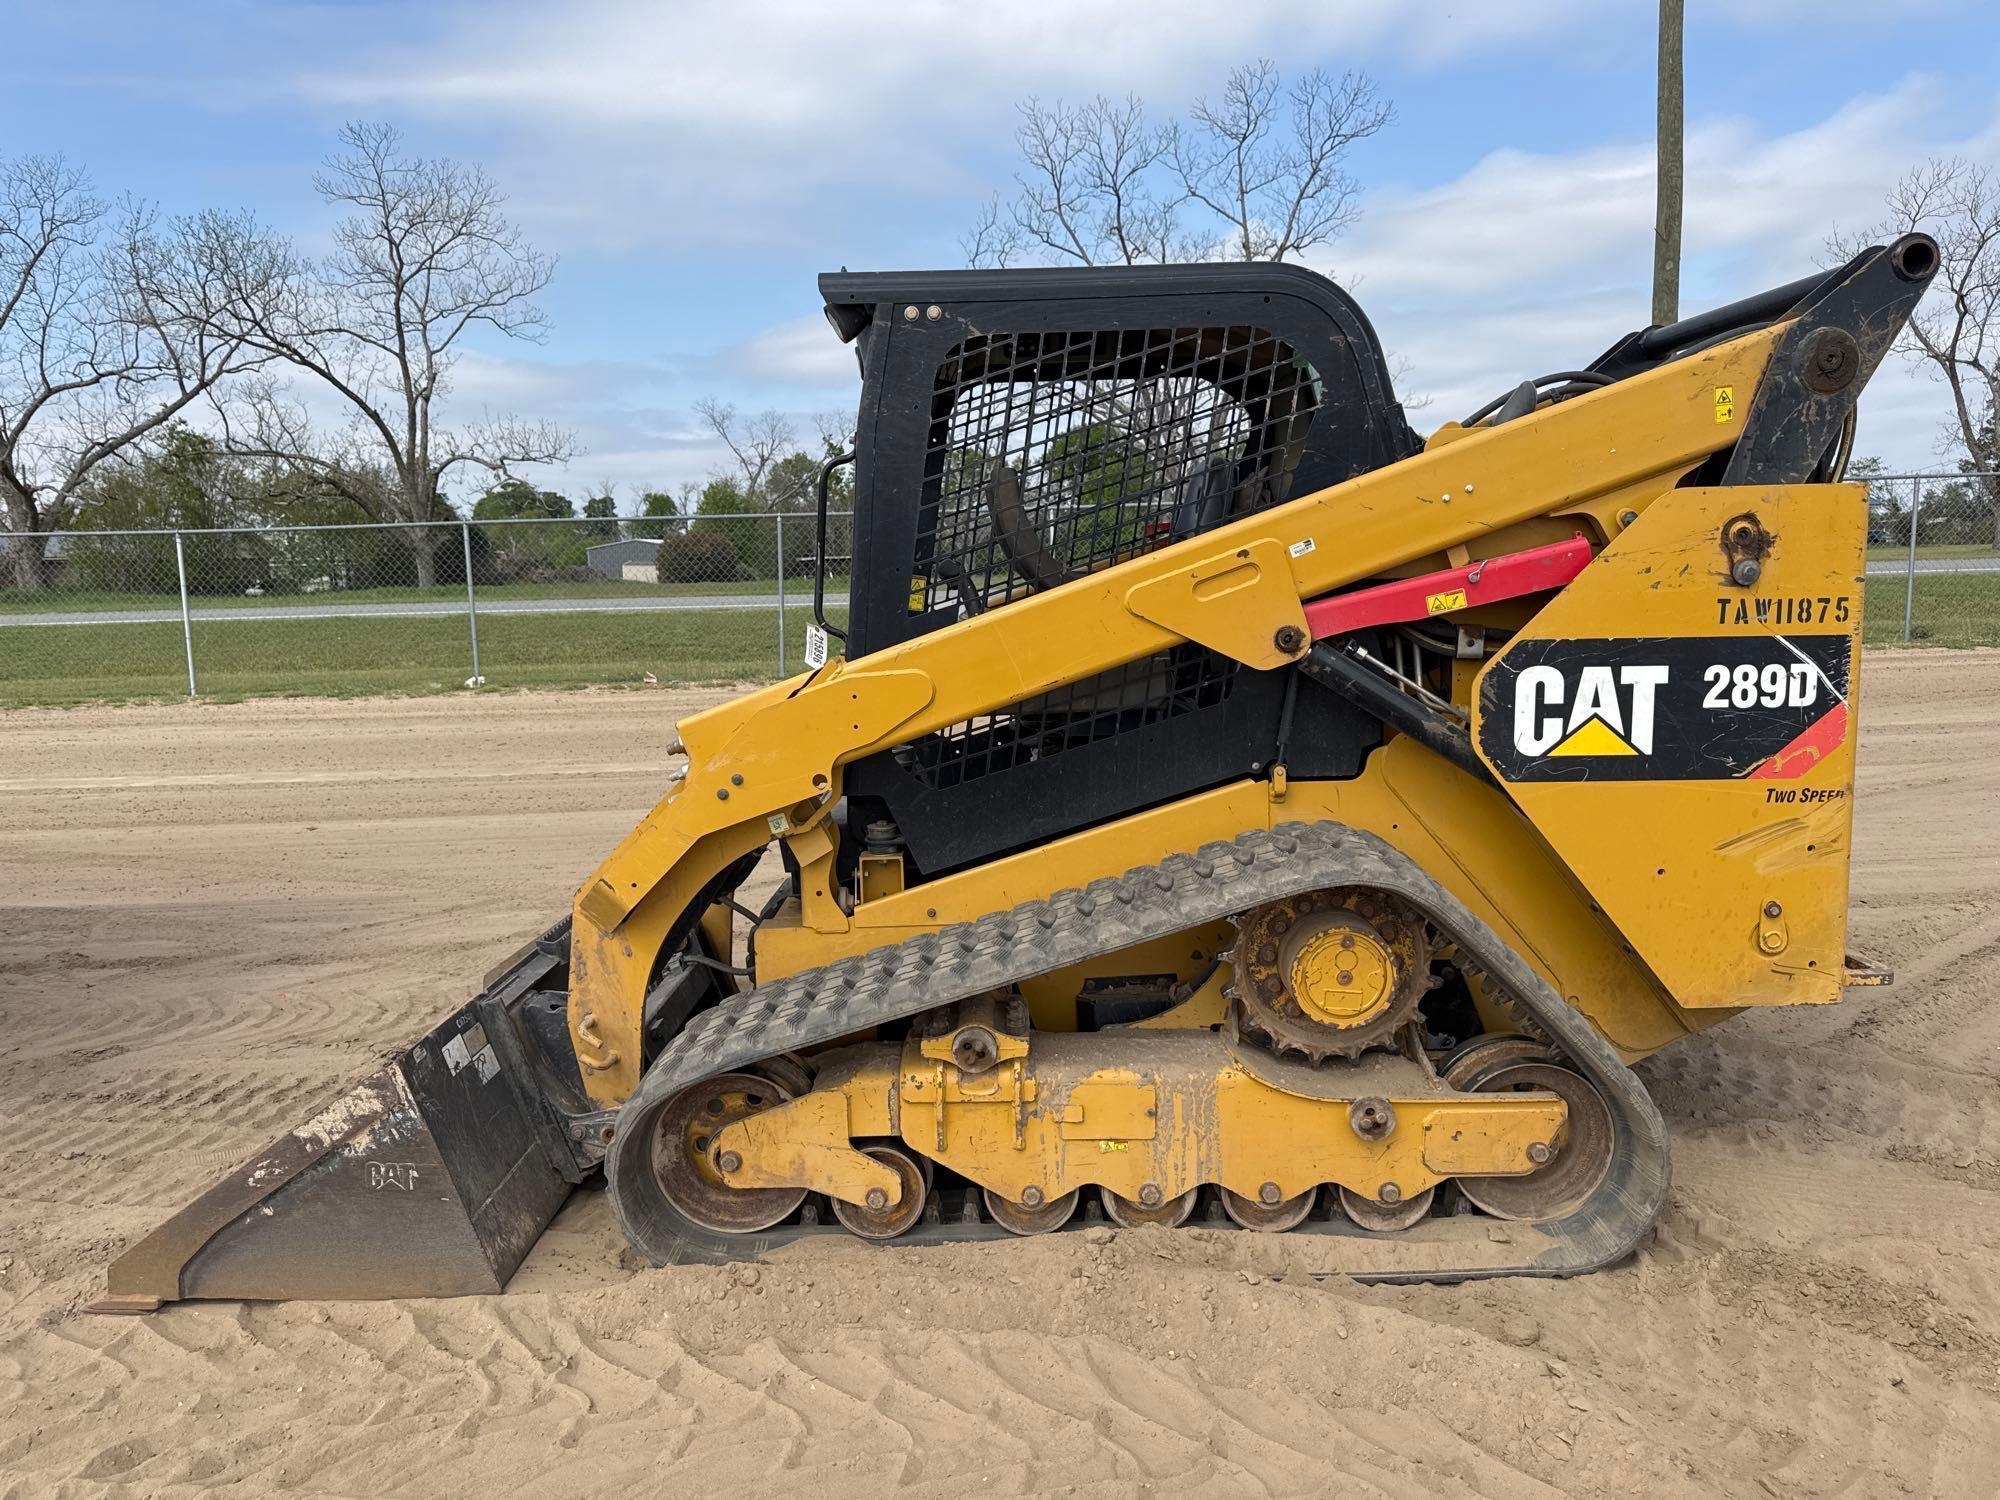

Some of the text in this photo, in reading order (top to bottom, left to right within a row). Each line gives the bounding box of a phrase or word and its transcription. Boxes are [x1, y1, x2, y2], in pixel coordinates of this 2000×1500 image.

[1717, 597, 1849, 625] TAW11875
[1702, 663, 1818, 709] 289D
[1513, 665, 1669, 757] CAT
[365, 1161, 416, 1190] CAT
